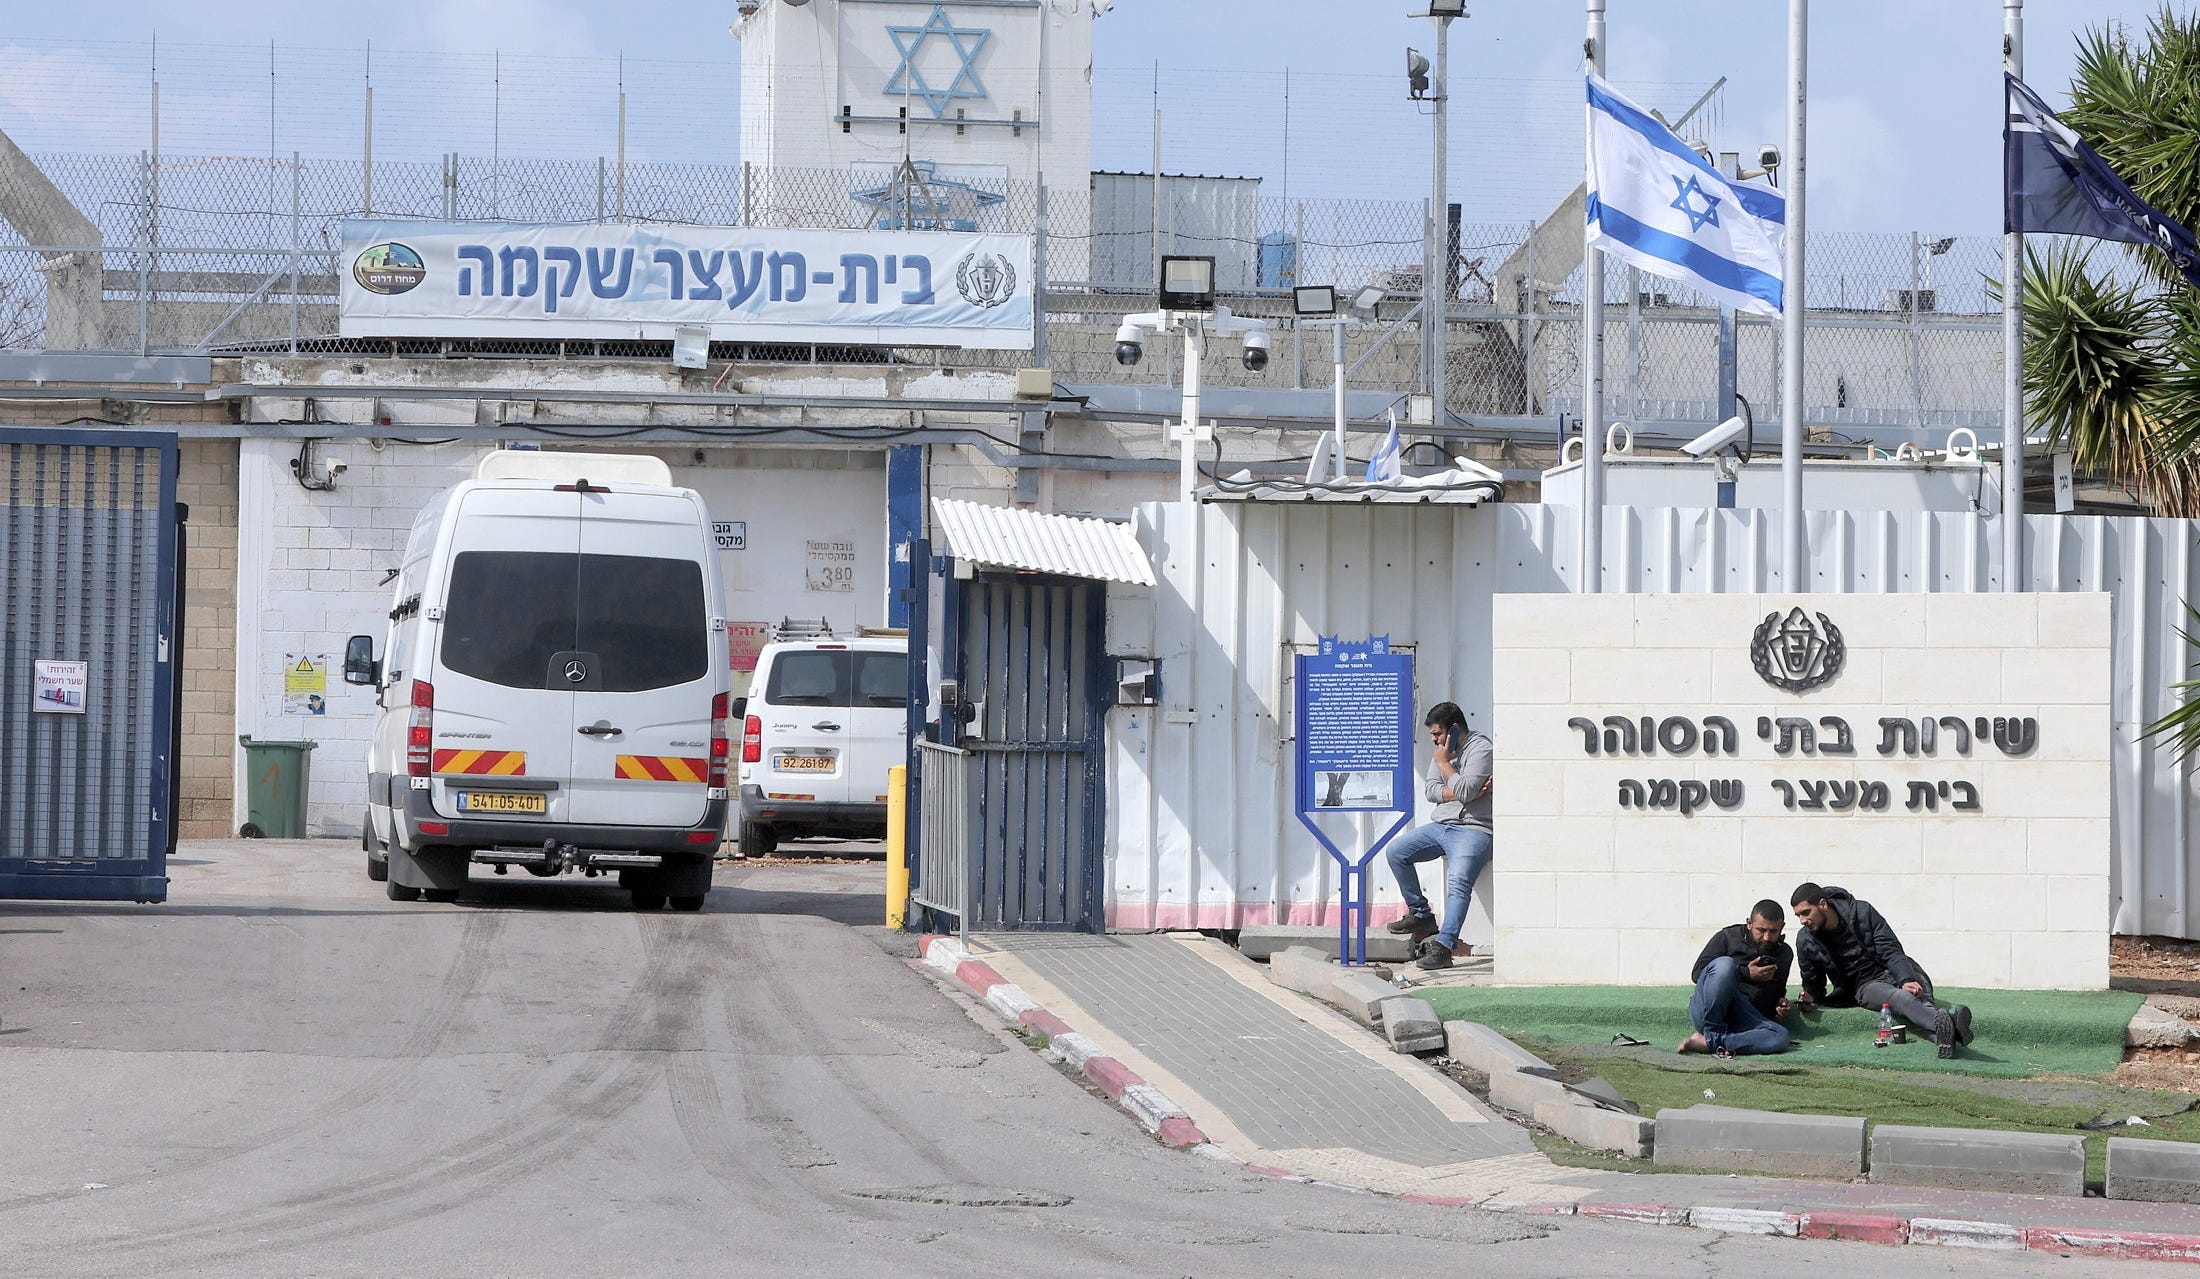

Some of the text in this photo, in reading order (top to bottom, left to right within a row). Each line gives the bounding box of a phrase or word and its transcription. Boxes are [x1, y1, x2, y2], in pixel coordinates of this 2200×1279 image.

[370, 275, 416, 284] מחוז דרום
[457, 244, 635, 313] שקמה
[715, 535, 743, 547] מקסי
[727, 626, 755, 636] זהיר
[47, 665, 76, 674] זהירות!
[38, 676, 83, 685] שער חשמלי
[1567, 715, 2037, 754] שירות בתי הסוהר
[1618, 778, 1981, 814] בית מעצר שקמה
